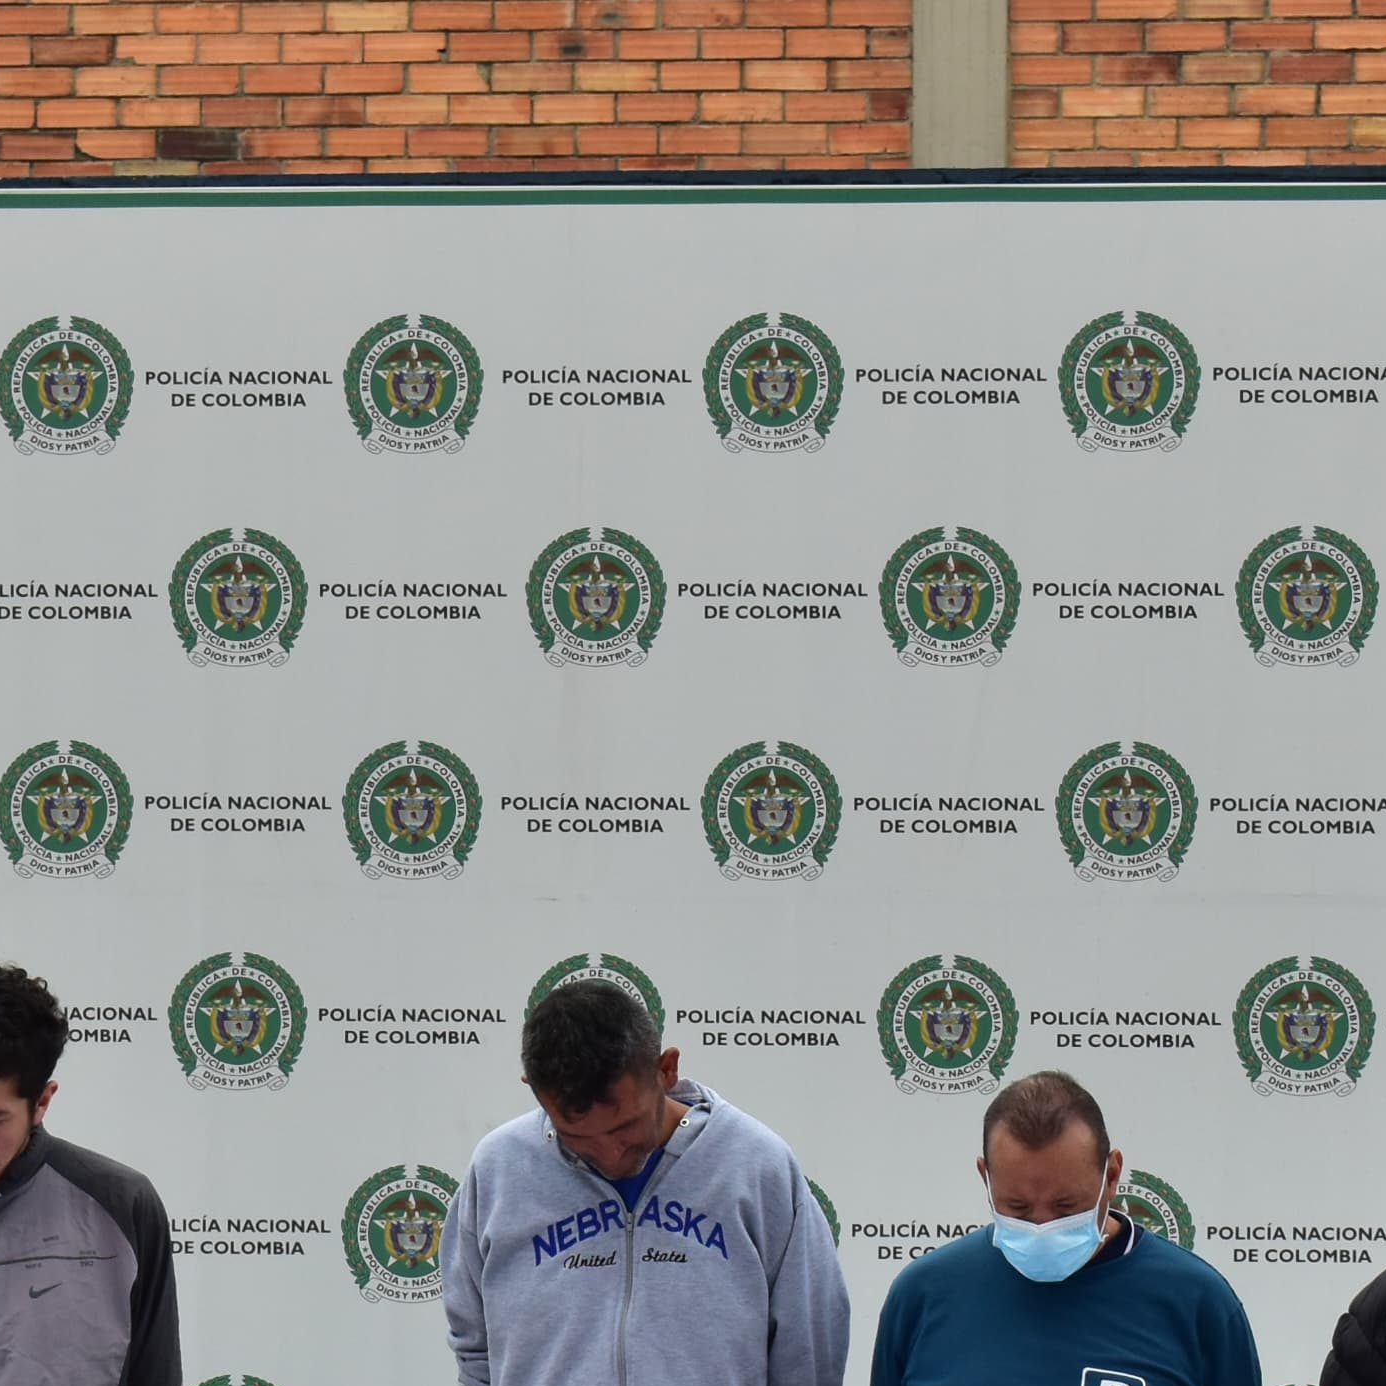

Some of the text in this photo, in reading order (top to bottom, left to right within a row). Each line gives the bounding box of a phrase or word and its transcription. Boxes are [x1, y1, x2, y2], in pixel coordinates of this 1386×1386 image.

[146, 367, 333, 385] POLICÍA NACIONAL
[856, 364, 1047, 382] POLICÍA NACIONAL
[172, 393, 306, 407] DE COLOMBIA
[882, 390, 1020, 404] DE COLOMBIA
[320, 579, 507, 597] POLICÍA NACIONAL
[1033, 578, 1224, 596] POLICÍA NACIONAL
[346, 606, 481, 619] DE COLOMBIA
[1060, 605, 1197, 619] DE COLOMBIA
[1121, 757, 1137, 765] DE
[1147, 764, 1180, 819] COLOMBIA
[501, 792, 690, 810] POLICÍA NACIONAL
[1210, 793, 1289, 811] POLICÍA
[528, 819, 663, 832] DE COLOMBIA
[1237, 821, 1375, 834] DE COLOMBIA
[1127, 832, 1175, 864] NACIONAL
[1127, 862, 1163, 878] PATRIA
[319, 1004, 506, 1022] POLICÍA NACIONAL
[70, 1029, 132, 1042] OMBIA
[345, 1030, 480, 1044] DE COLOMBIA
[171, 1215, 331, 1233] LICÍA NACIONAL
[532, 1195, 728, 1267] NEBRASKA
[1207, 1222, 1286, 1240] POLICÍA
[171, 1241, 304, 1255] DE COLOMBIA
[1234, 1249, 1372, 1263] DE COLOMBIA
[564, 1248, 688, 1269] United States
